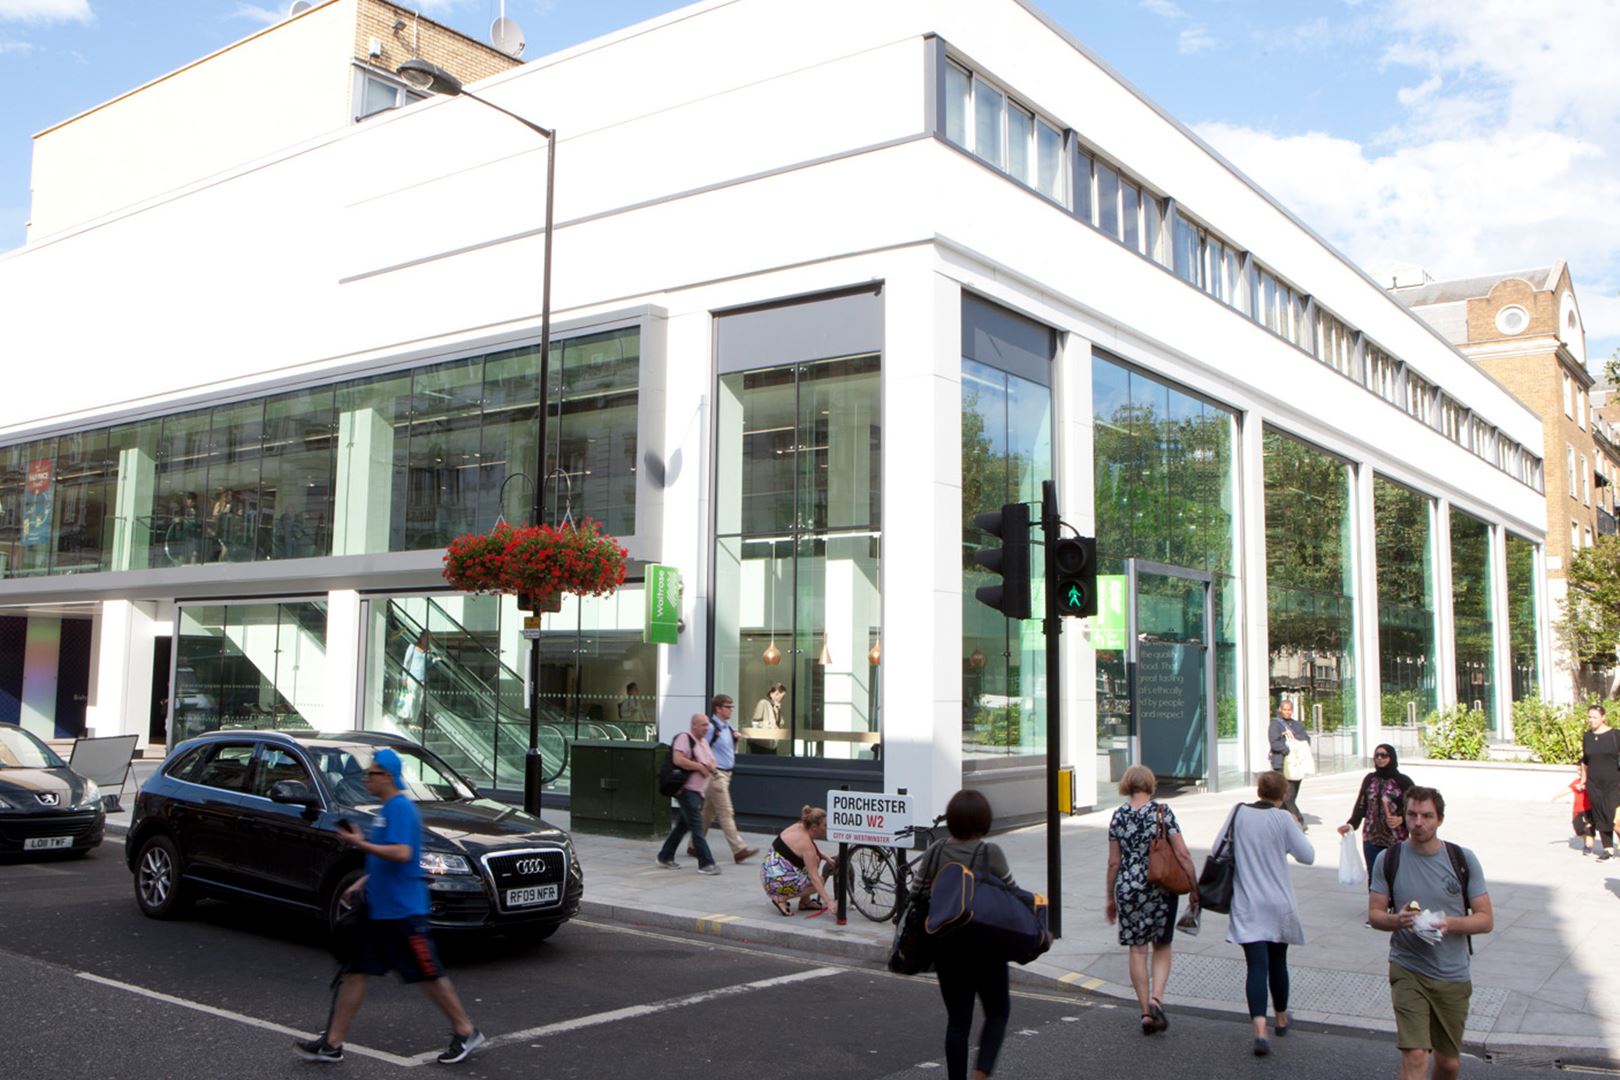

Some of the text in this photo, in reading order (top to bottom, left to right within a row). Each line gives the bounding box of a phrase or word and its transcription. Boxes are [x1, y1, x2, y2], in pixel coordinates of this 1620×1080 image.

[656, 569, 665, 617] Waitrose
[833, 796, 906, 814] PORCHESTER
[833, 813, 885, 829] ROAD W2
[833, 832, 890, 843] CITY OF WESTMINSTER
[510, 889, 535, 904] RF09
[537, 887, 555, 899] NFR
